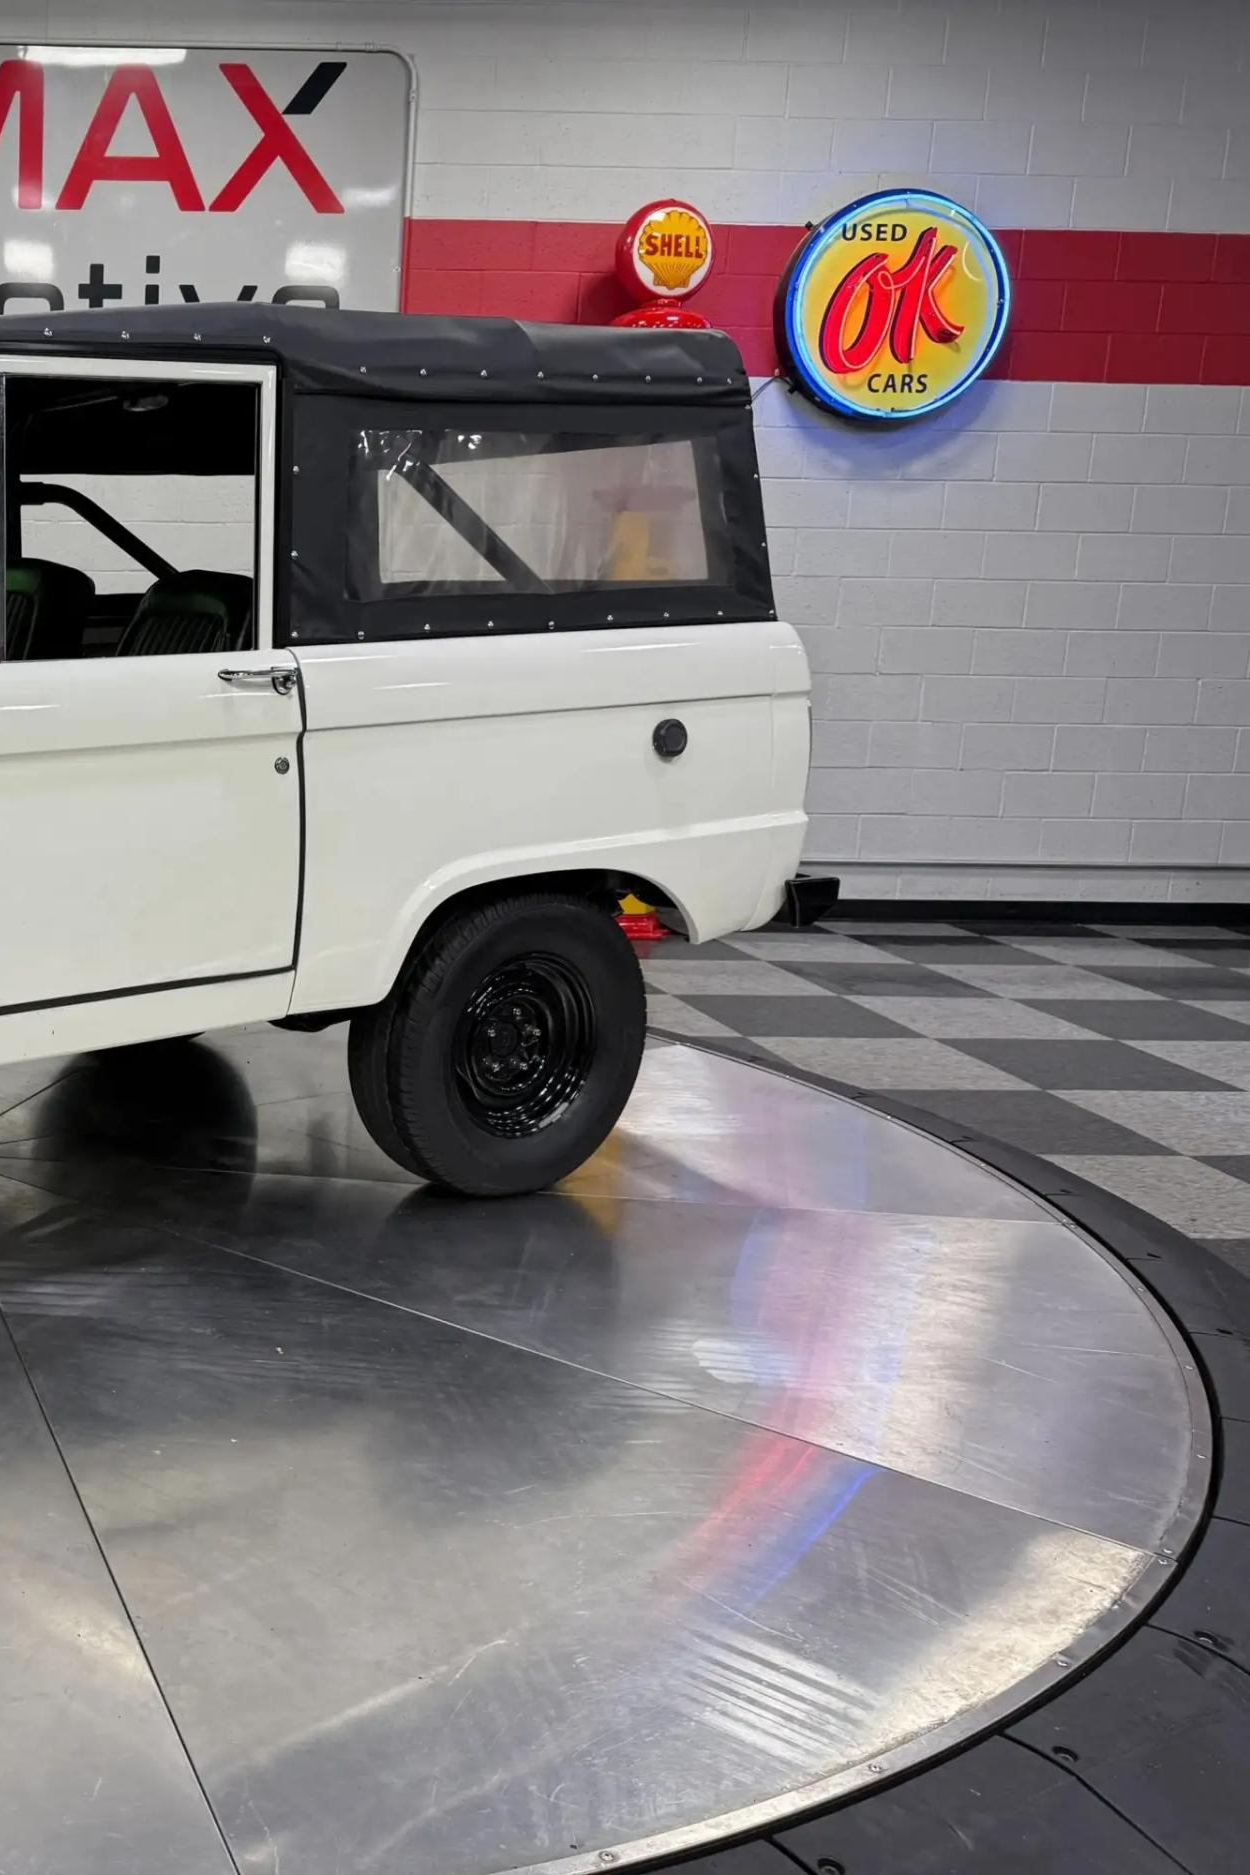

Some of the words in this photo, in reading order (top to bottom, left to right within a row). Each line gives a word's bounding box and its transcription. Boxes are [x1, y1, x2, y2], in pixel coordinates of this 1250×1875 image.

[841, 223, 908, 242] USED
[644, 232, 705, 260] SHELL
[818, 226, 965, 375] OK
[867, 372, 928, 395] CARS
